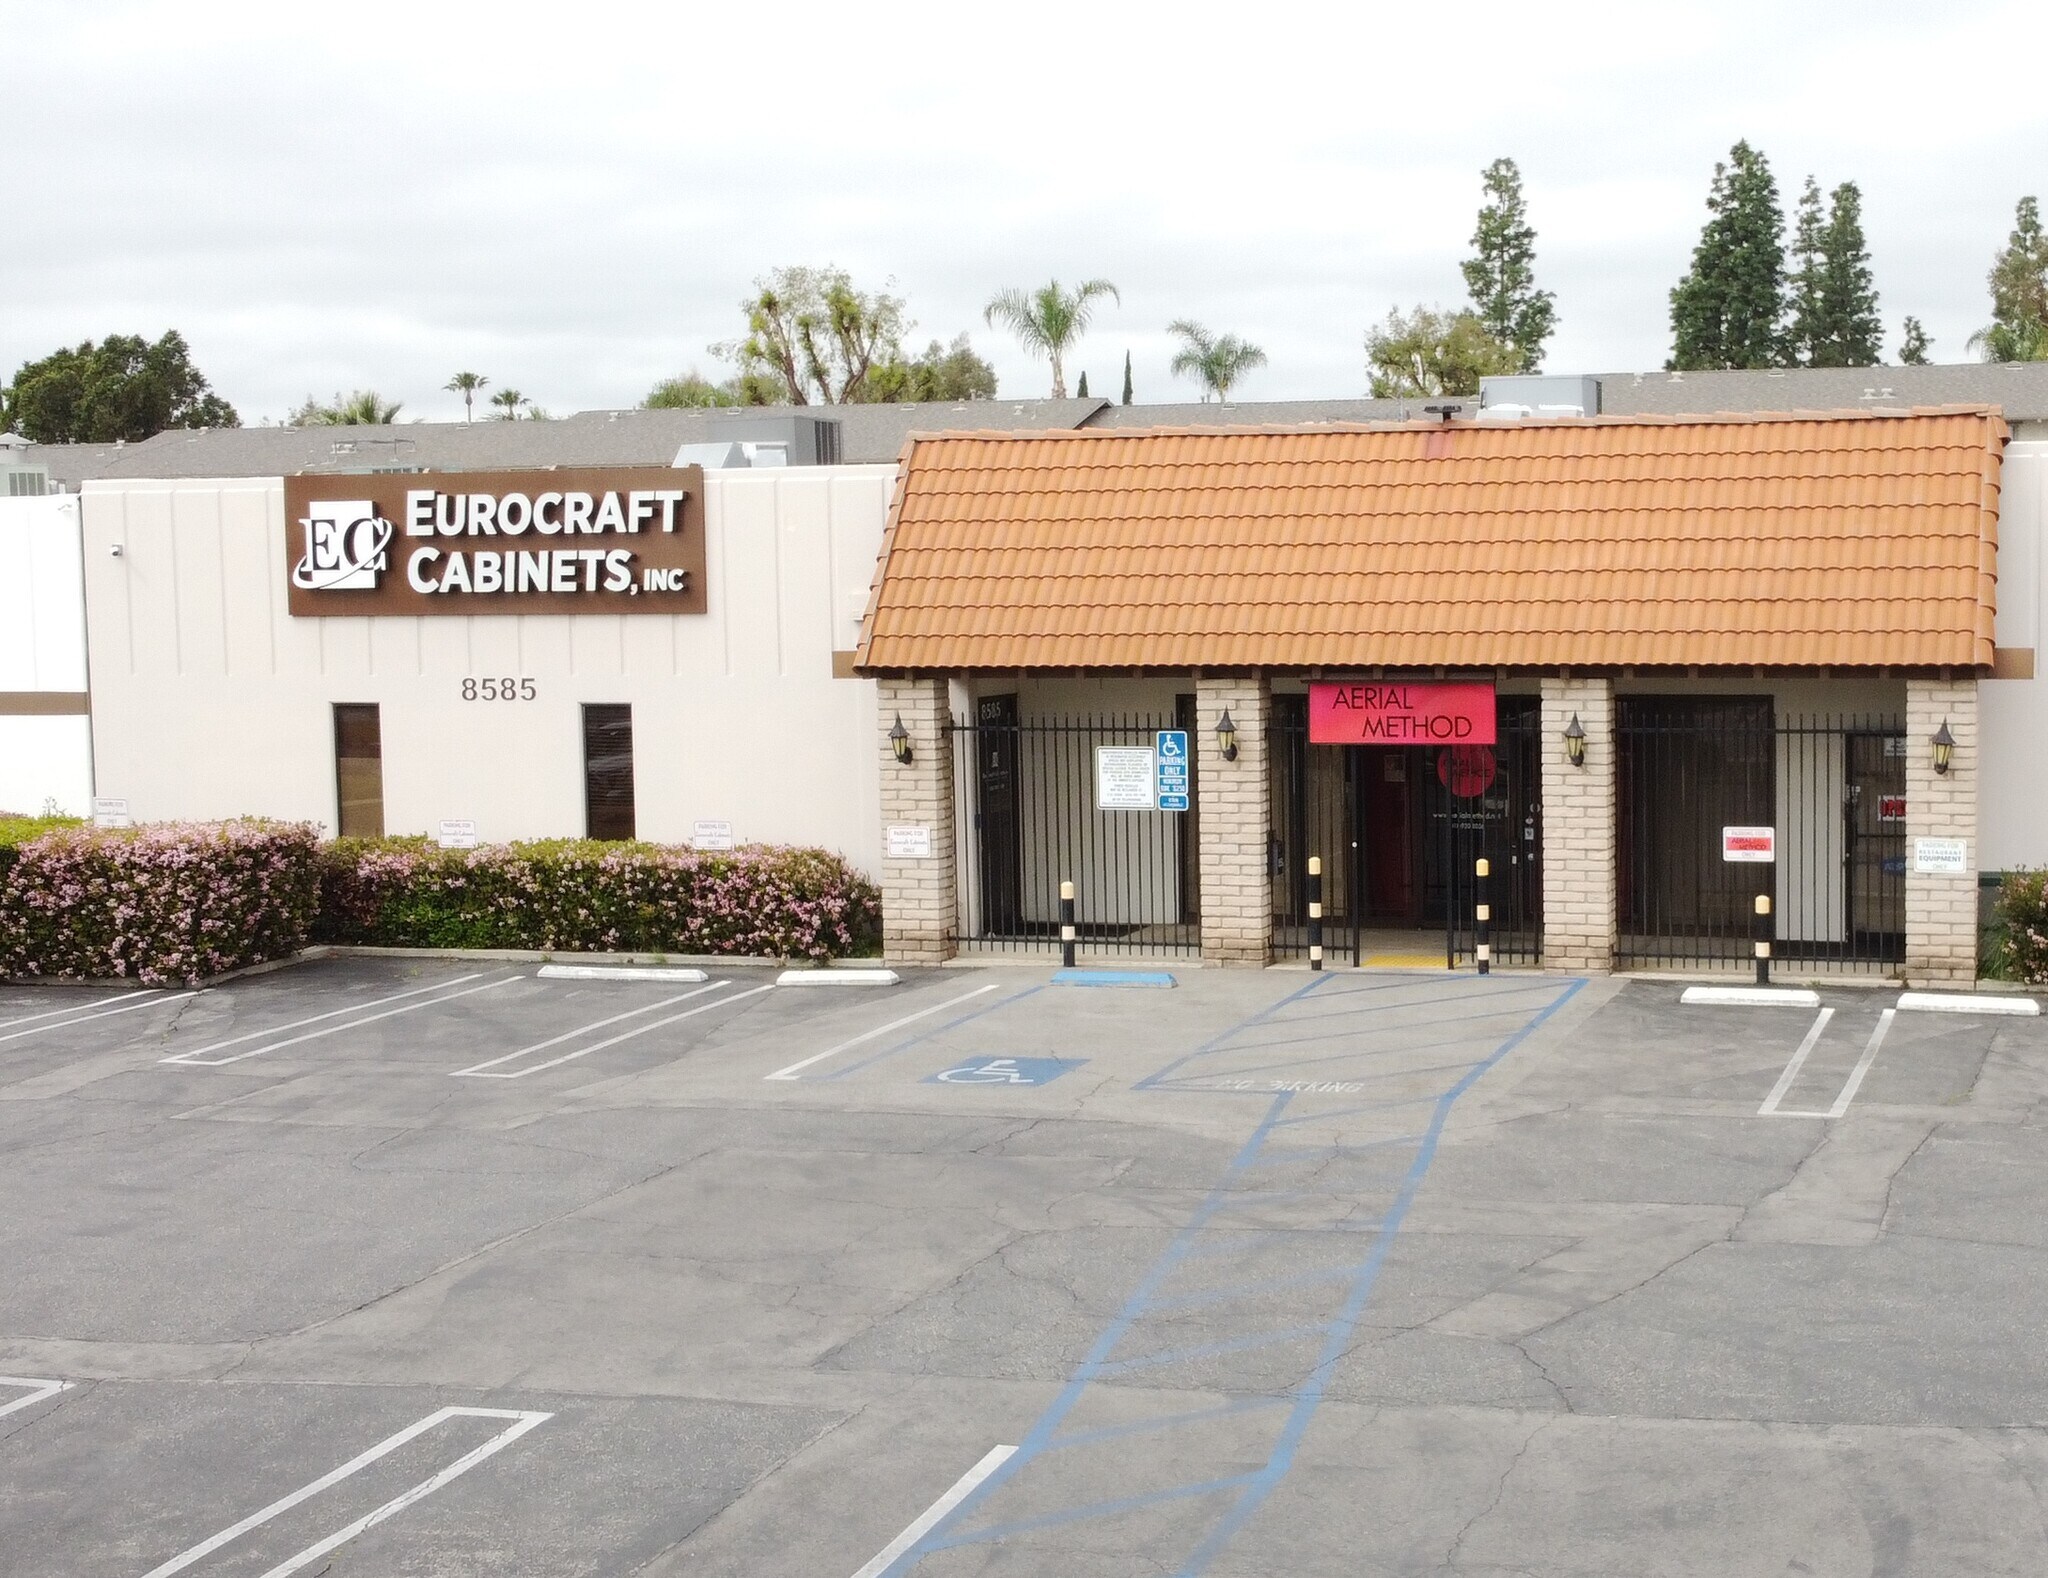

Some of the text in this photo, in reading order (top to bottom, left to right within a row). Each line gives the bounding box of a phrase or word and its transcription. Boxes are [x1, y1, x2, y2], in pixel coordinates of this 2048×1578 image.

[406, 489, 684, 536] EUROCRAFT
[407, 546, 685, 596] CABINETS, INC
[461, 677, 537, 701] 8585
[1332, 687, 1414, 710] AERIAL
[1361, 715, 1473, 739] METHOD
[1159, 756, 1186, 766] PARKING
[1164, 766, 1181, 776] ONLY
